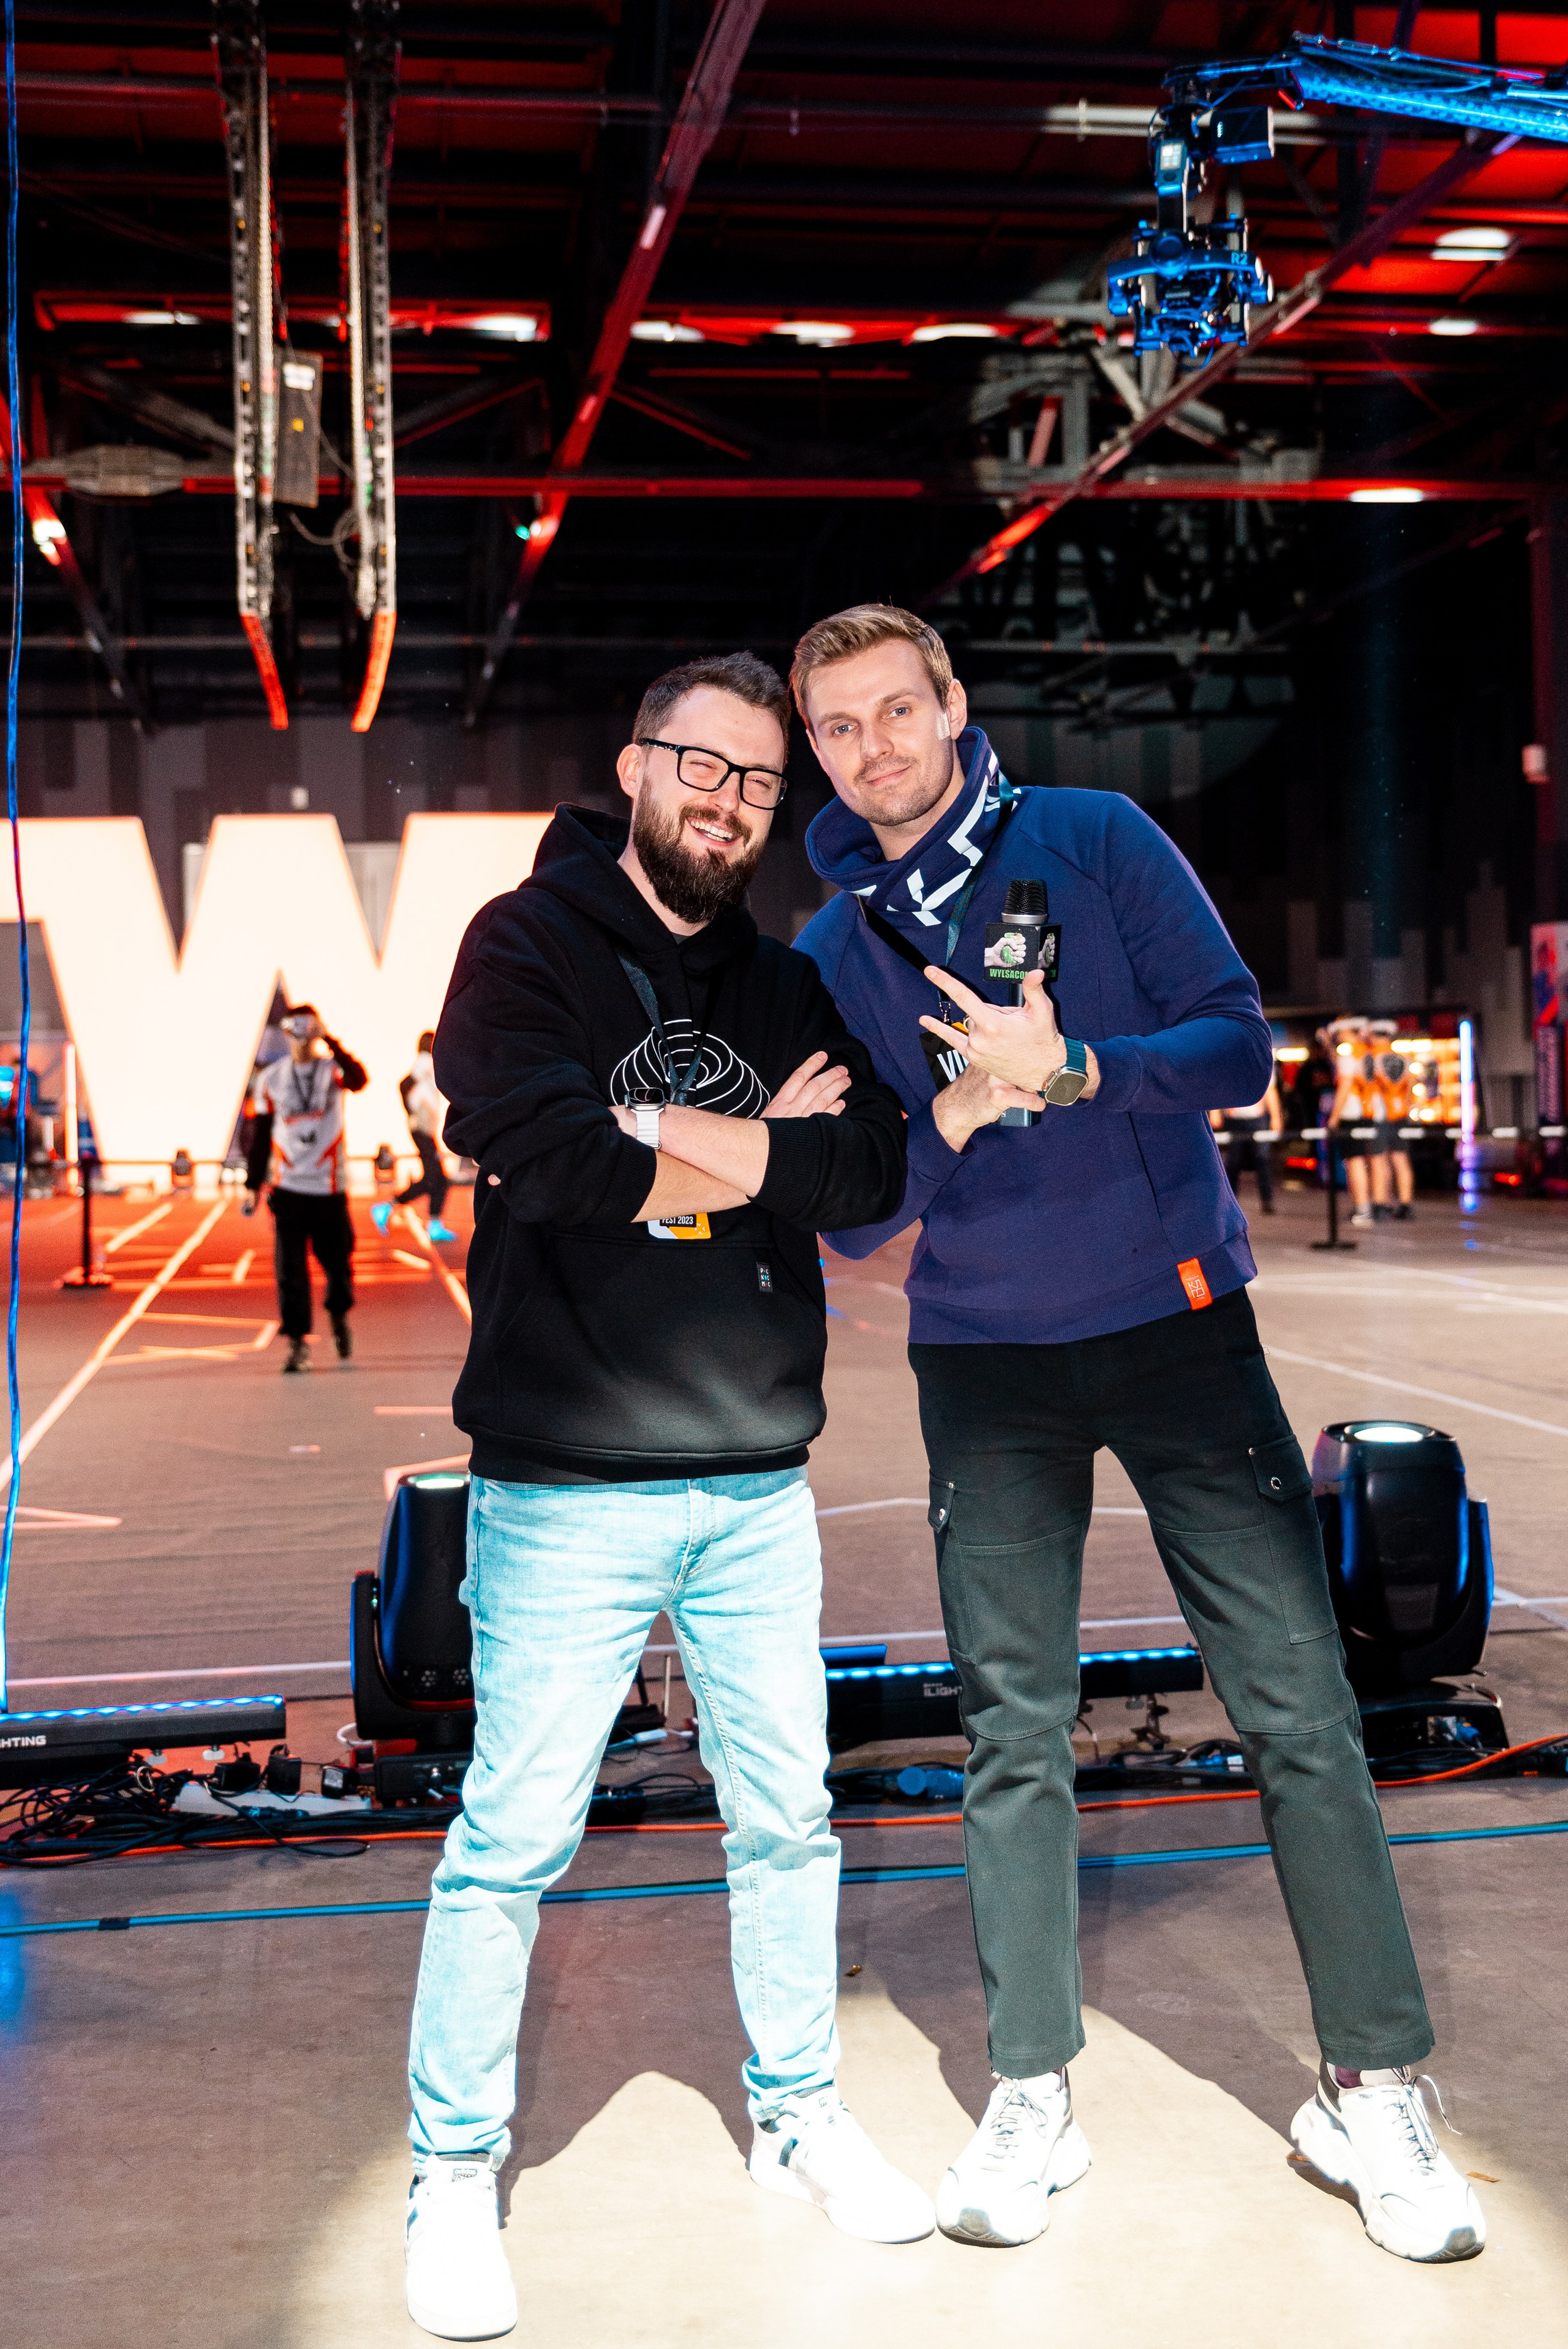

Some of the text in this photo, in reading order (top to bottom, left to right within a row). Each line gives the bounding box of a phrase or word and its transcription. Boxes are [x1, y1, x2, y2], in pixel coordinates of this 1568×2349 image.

[1231, 251, 1248, 265] R2
[989, 968, 1029, 979] WYLSACO
[937, 1049, 969, 1082] VI
[677, 1216, 693, 1224] 2023
[0, 1735, 47, 1748] HTING
